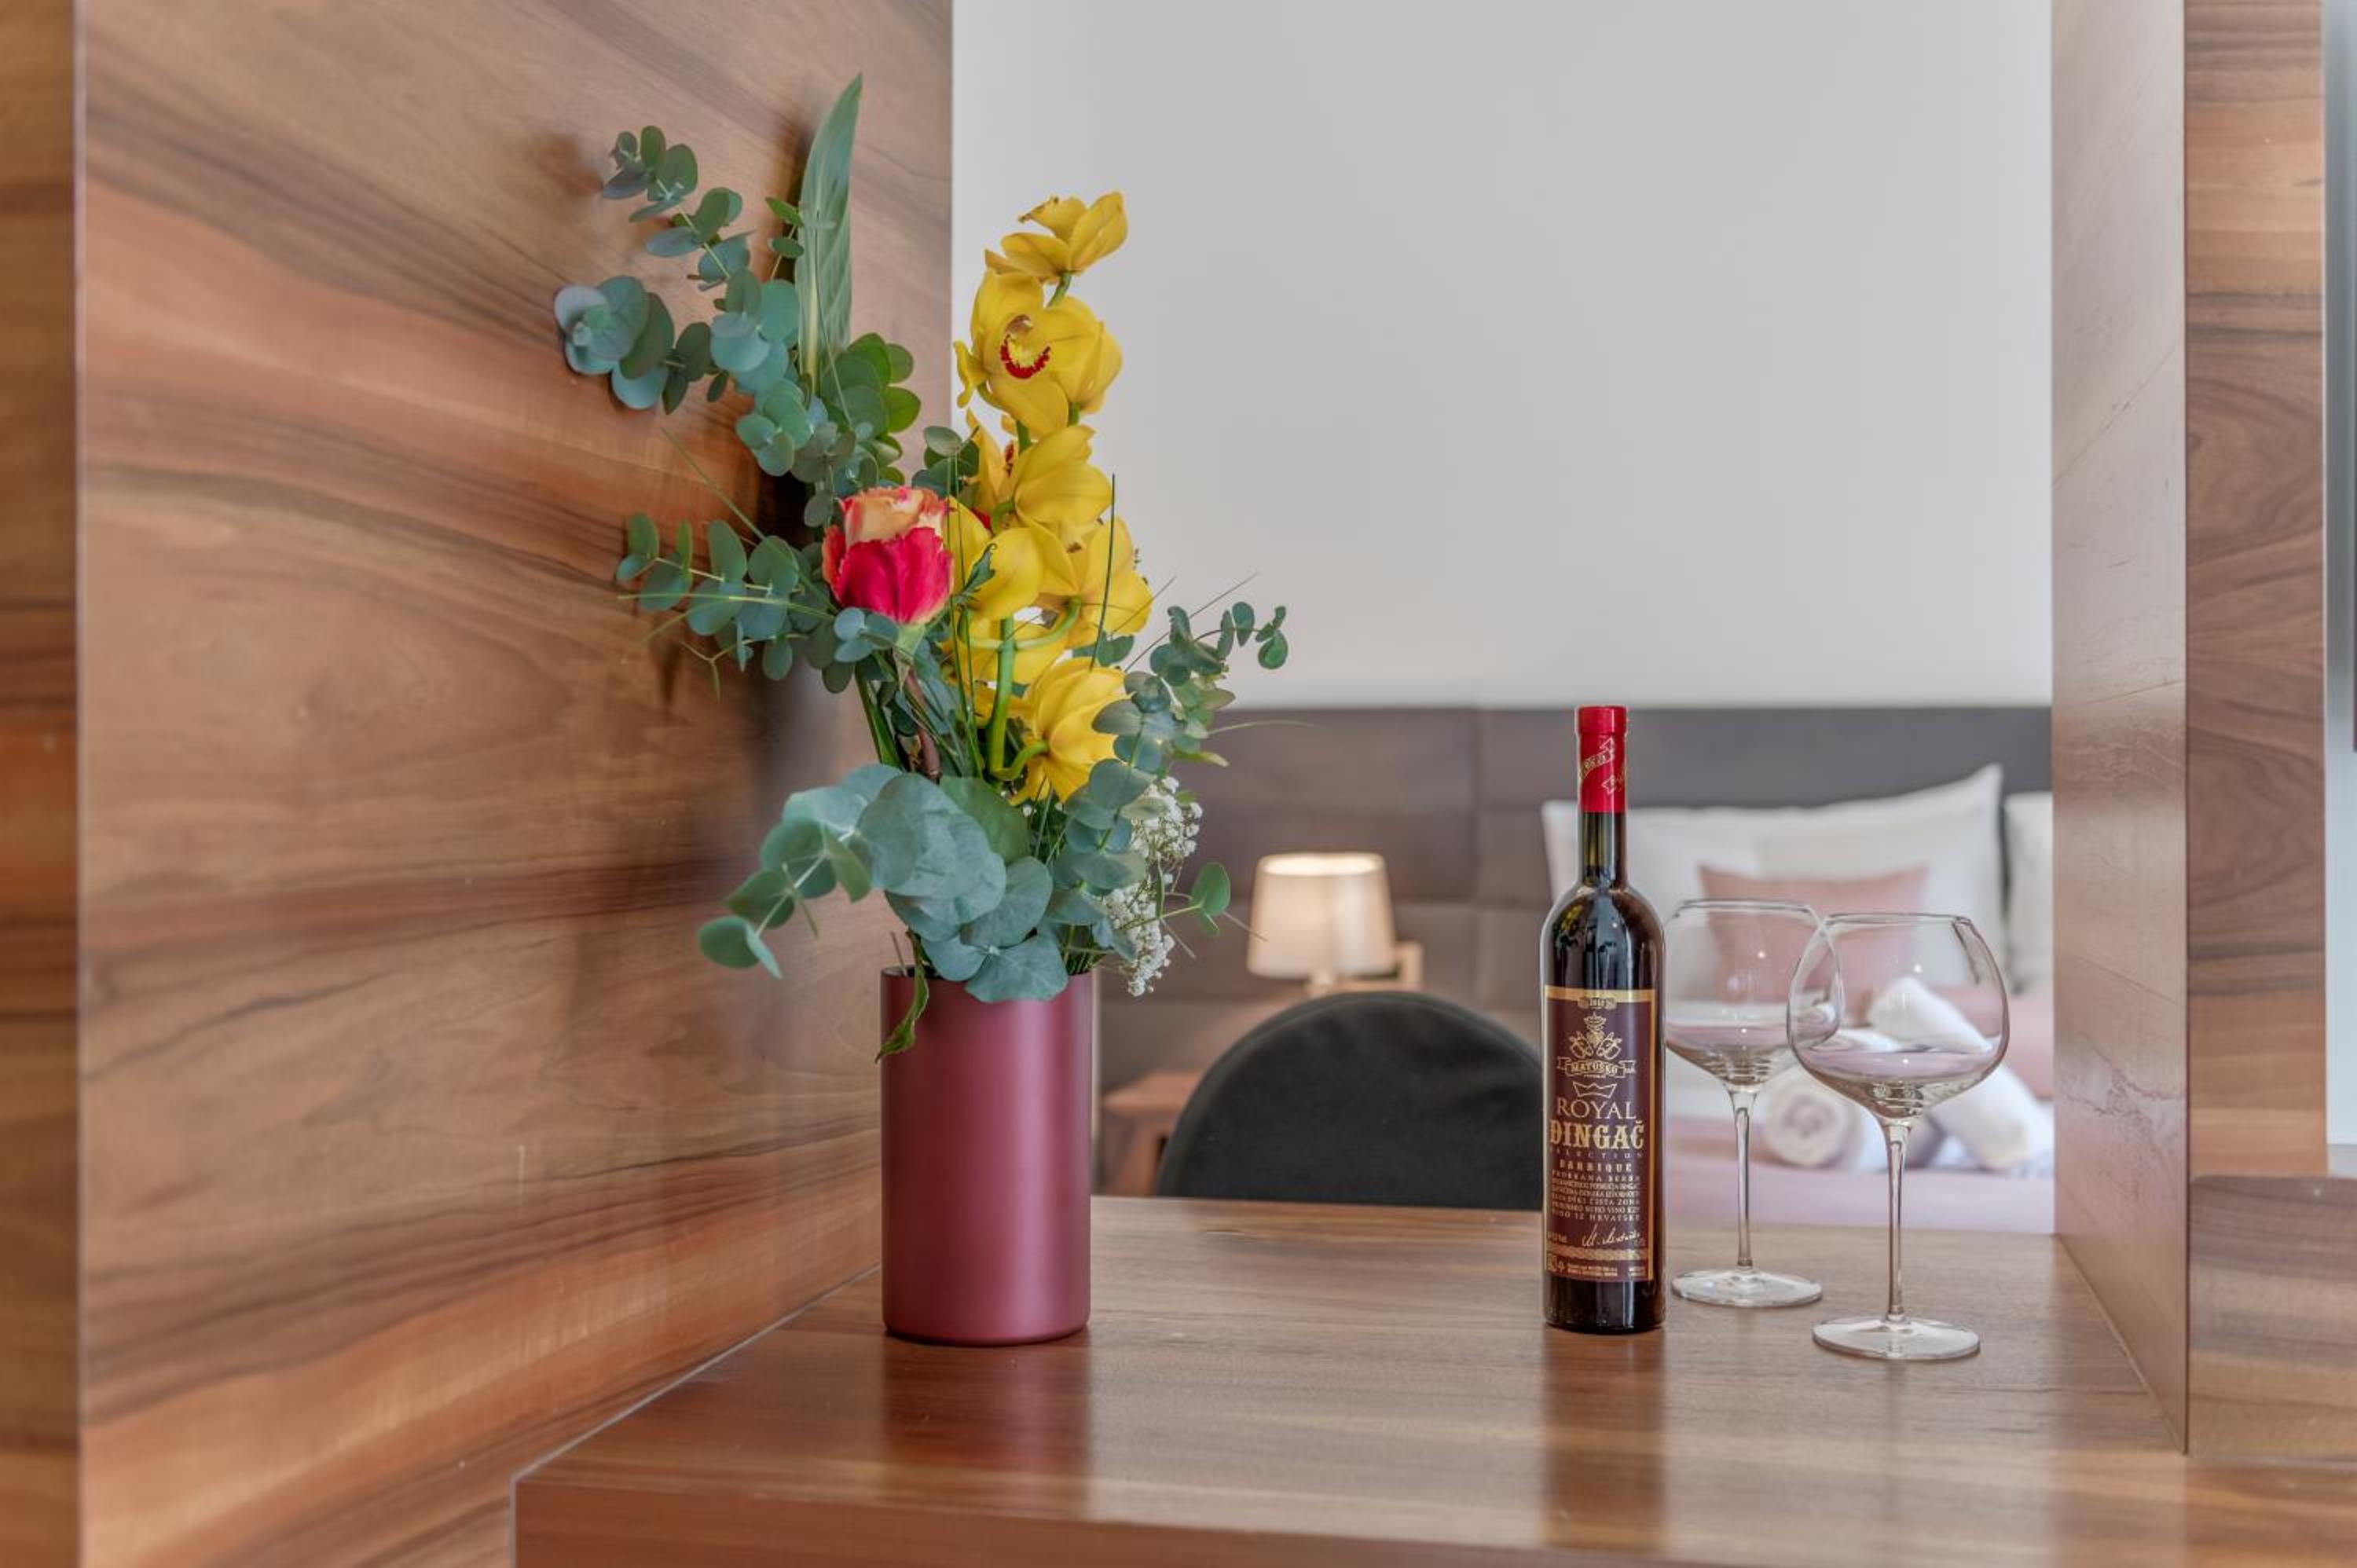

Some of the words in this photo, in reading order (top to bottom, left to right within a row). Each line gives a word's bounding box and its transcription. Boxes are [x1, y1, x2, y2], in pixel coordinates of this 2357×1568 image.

[1557, 1097, 1637, 1119] ROYAL
[1549, 1119, 1644, 1149] DINGAČ
[1560, 1159, 1632, 1173] BARRIQUE
